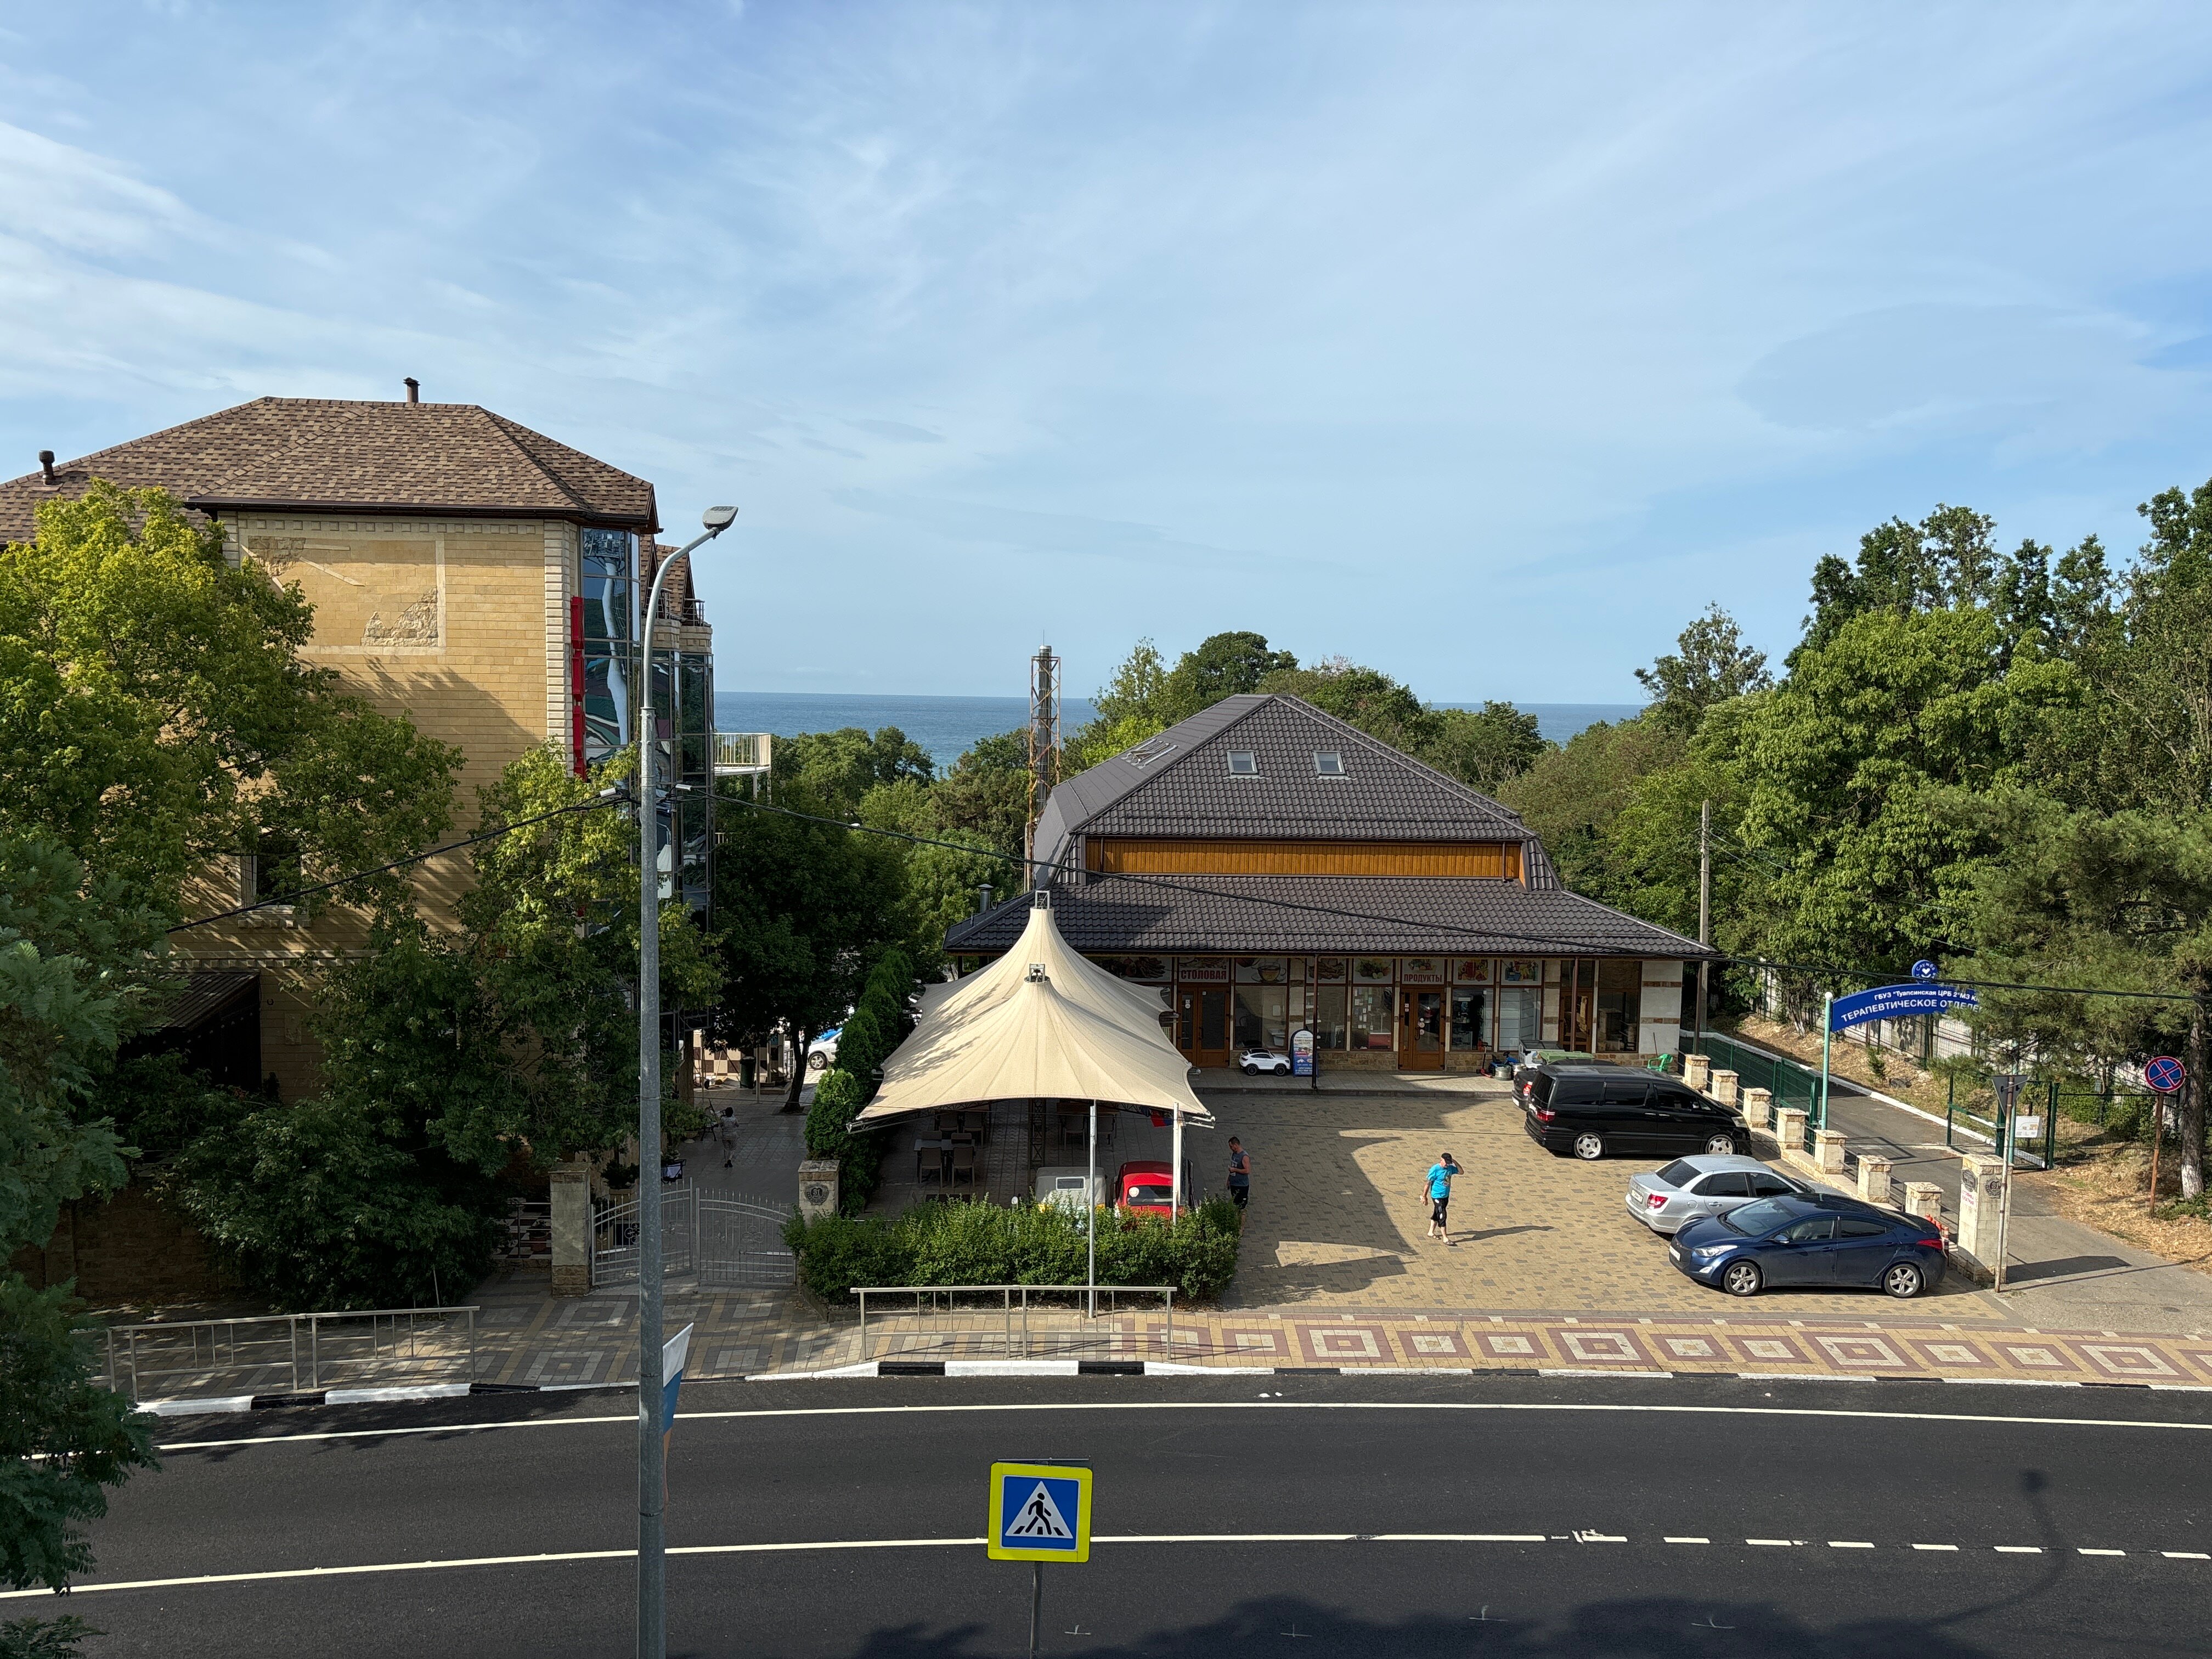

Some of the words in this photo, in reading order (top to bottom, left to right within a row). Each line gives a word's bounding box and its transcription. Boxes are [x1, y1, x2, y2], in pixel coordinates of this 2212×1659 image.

[1181, 969, 1227, 980] СТОЛОВАЯ
[1404, 974, 1442, 983] ПРОДУКТЫ
[1874, 992, 1892, 1001] ГБУЗ
[1841, 999, 1938, 1022] ТЕРАПЕВТИЧЕСКОЕ
